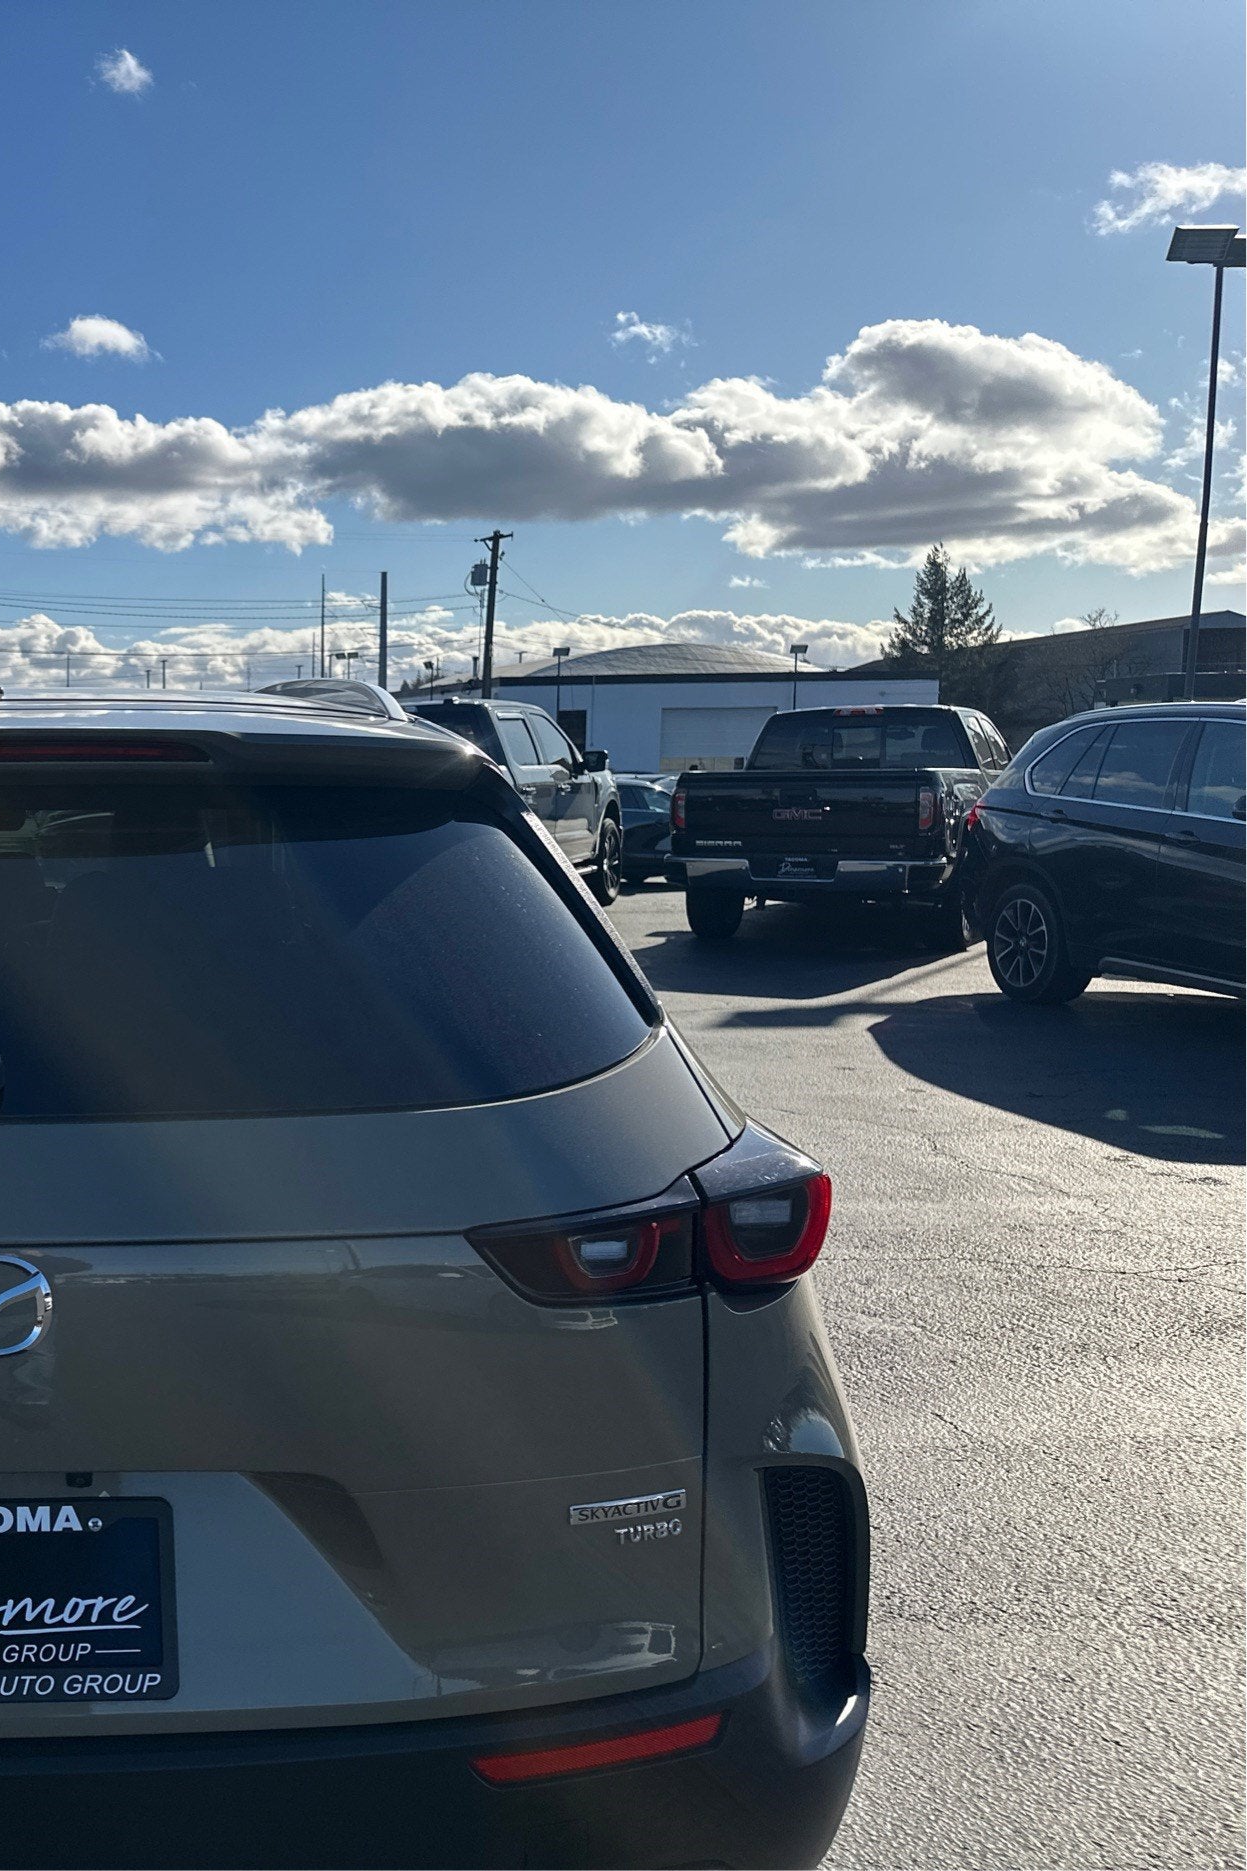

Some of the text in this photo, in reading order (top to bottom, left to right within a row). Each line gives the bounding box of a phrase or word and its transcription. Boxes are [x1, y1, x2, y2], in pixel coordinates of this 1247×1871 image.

[772, 808, 823, 821] GMC
[614, 1518, 683, 1545] TURBO
[2, 1643, 92, 1664] GROUP
[62, 1673, 162, 1695] GROUP
